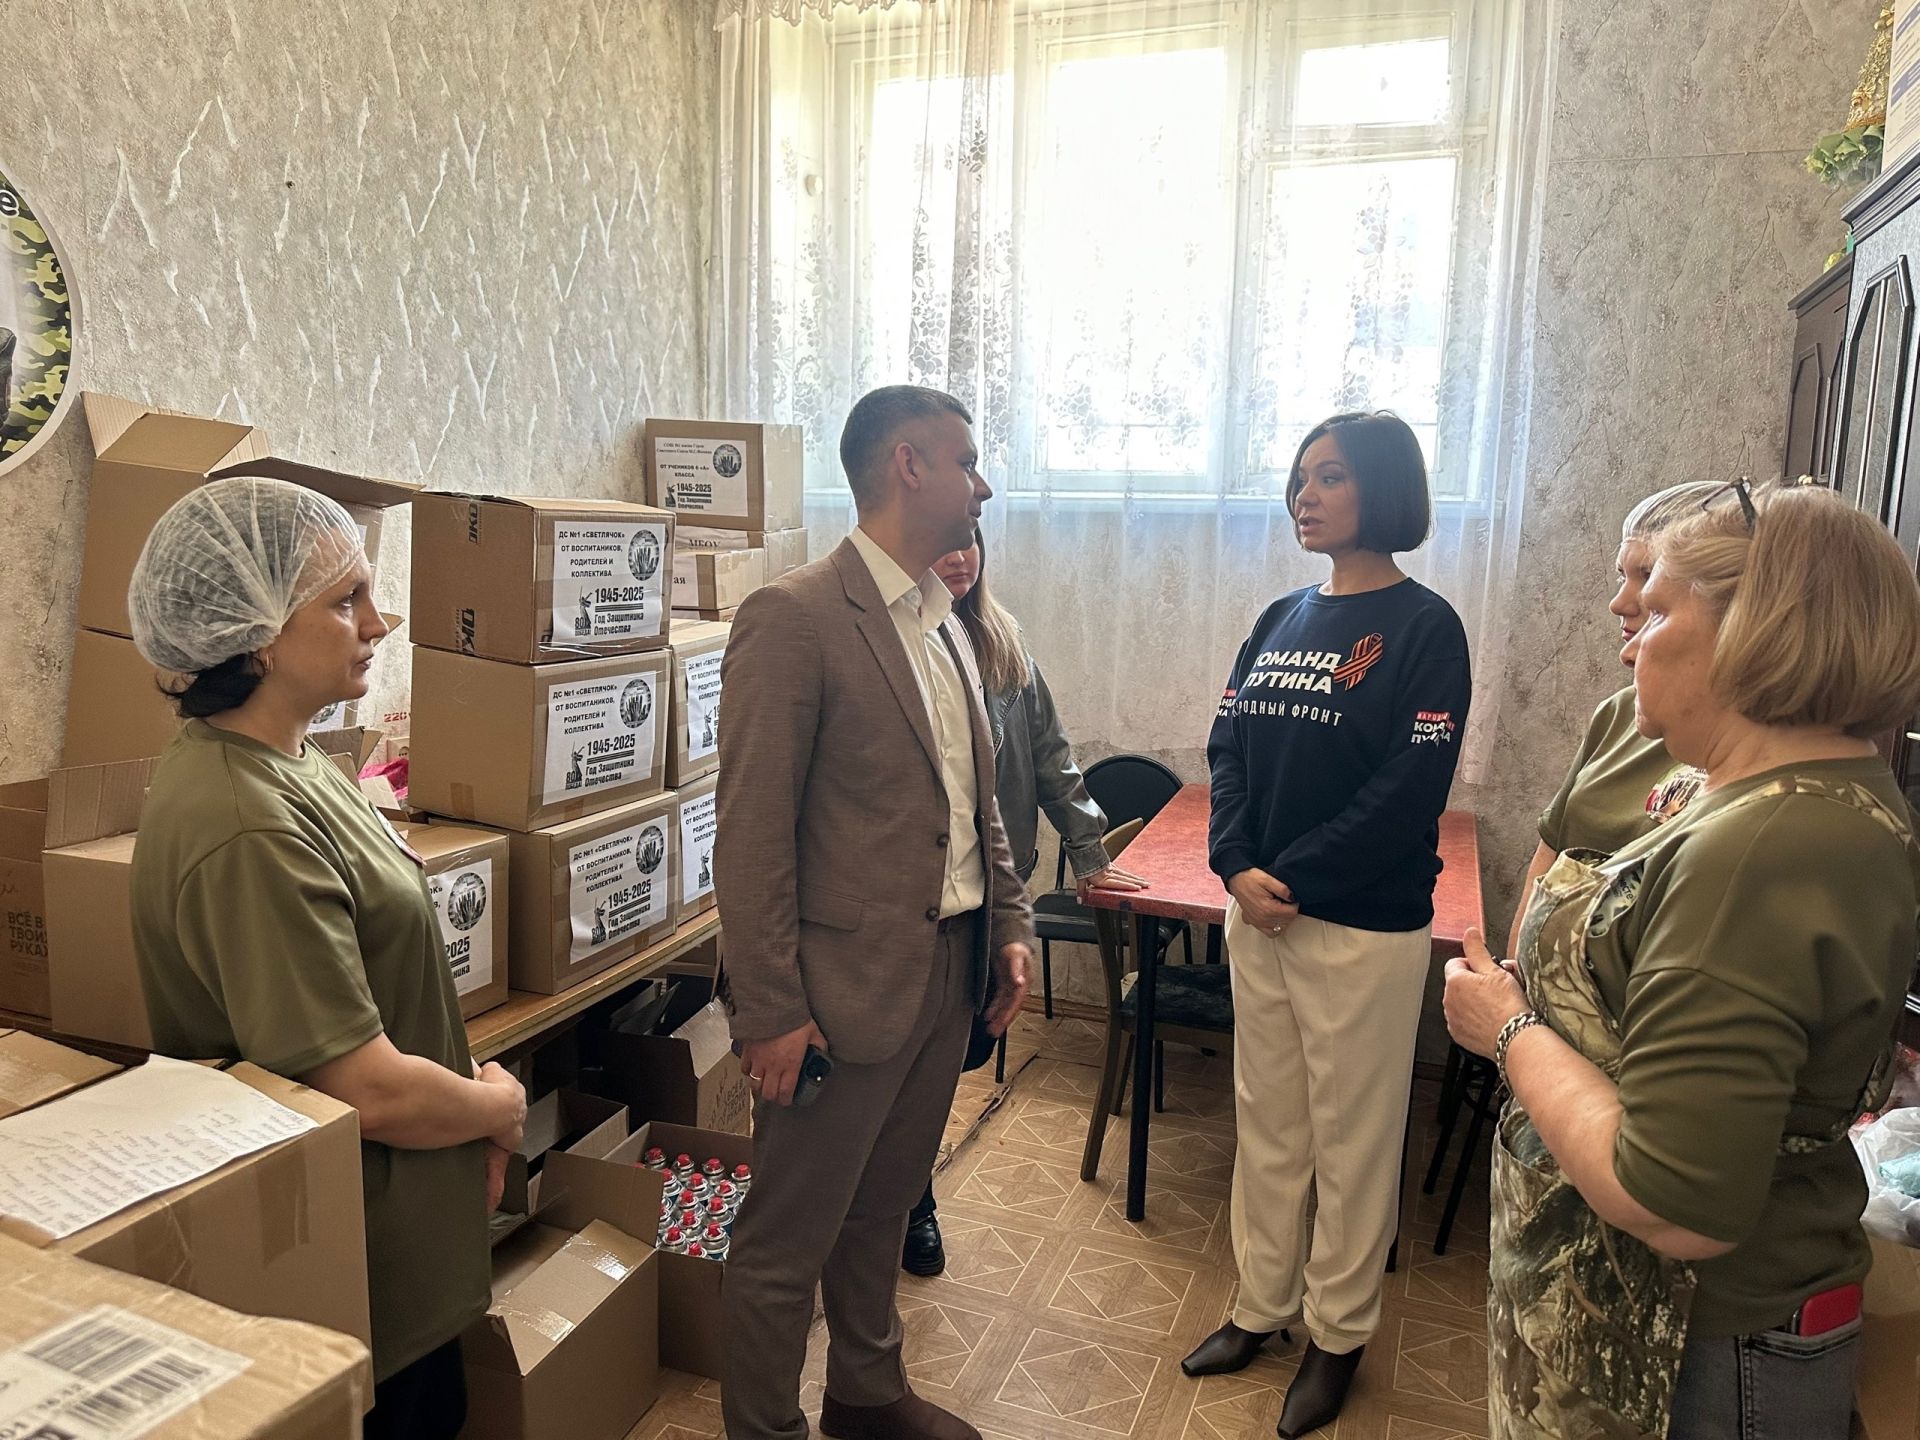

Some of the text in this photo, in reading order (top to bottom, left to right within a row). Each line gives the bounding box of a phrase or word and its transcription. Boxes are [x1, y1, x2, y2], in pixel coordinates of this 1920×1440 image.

[676, 483, 712, 492] 1945-2025
[570, 558, 607, 566] РОДИТЕЛЕЙ
[595, 587, 644, 603] 1945-2025
[594, 613, 643, 624] Год Защитника
[594, 625, 631, 635] Отечества
[1254, 650, 1342, 674] ОМАНД
[1242, 672, 1332, 694] ПУТИНА
[553, 691, 562, 699] ДС
[576, 684, 617, 695] «СВЕТЛЯЧОК»
[564, 712, 600, 723] РОДИТЕЛЕЙ
[1292, 704, 1342, 726] ФРОНТ
[564, 723, 604, 734] КОЛЛЕКТИВА
[588, 734, 635, 756] 1945-2025
[586, 759, 634, 776] Год Защитника
[574, 852, 582, 861] ДС
[595, 835, 632, 853] «СВЕТЛЯЧОК»
[585, 866, 617, 882] РОДИТЕЛЕЙ
[586, 874, 622, 893] КОЛЛЕКТИВА
[608, 879, 651, 909] 1945-2025
[608, 917, 619, 928] Год
[446, 936, 470, 959] 2025
[454, 965, 470, 979] ника
